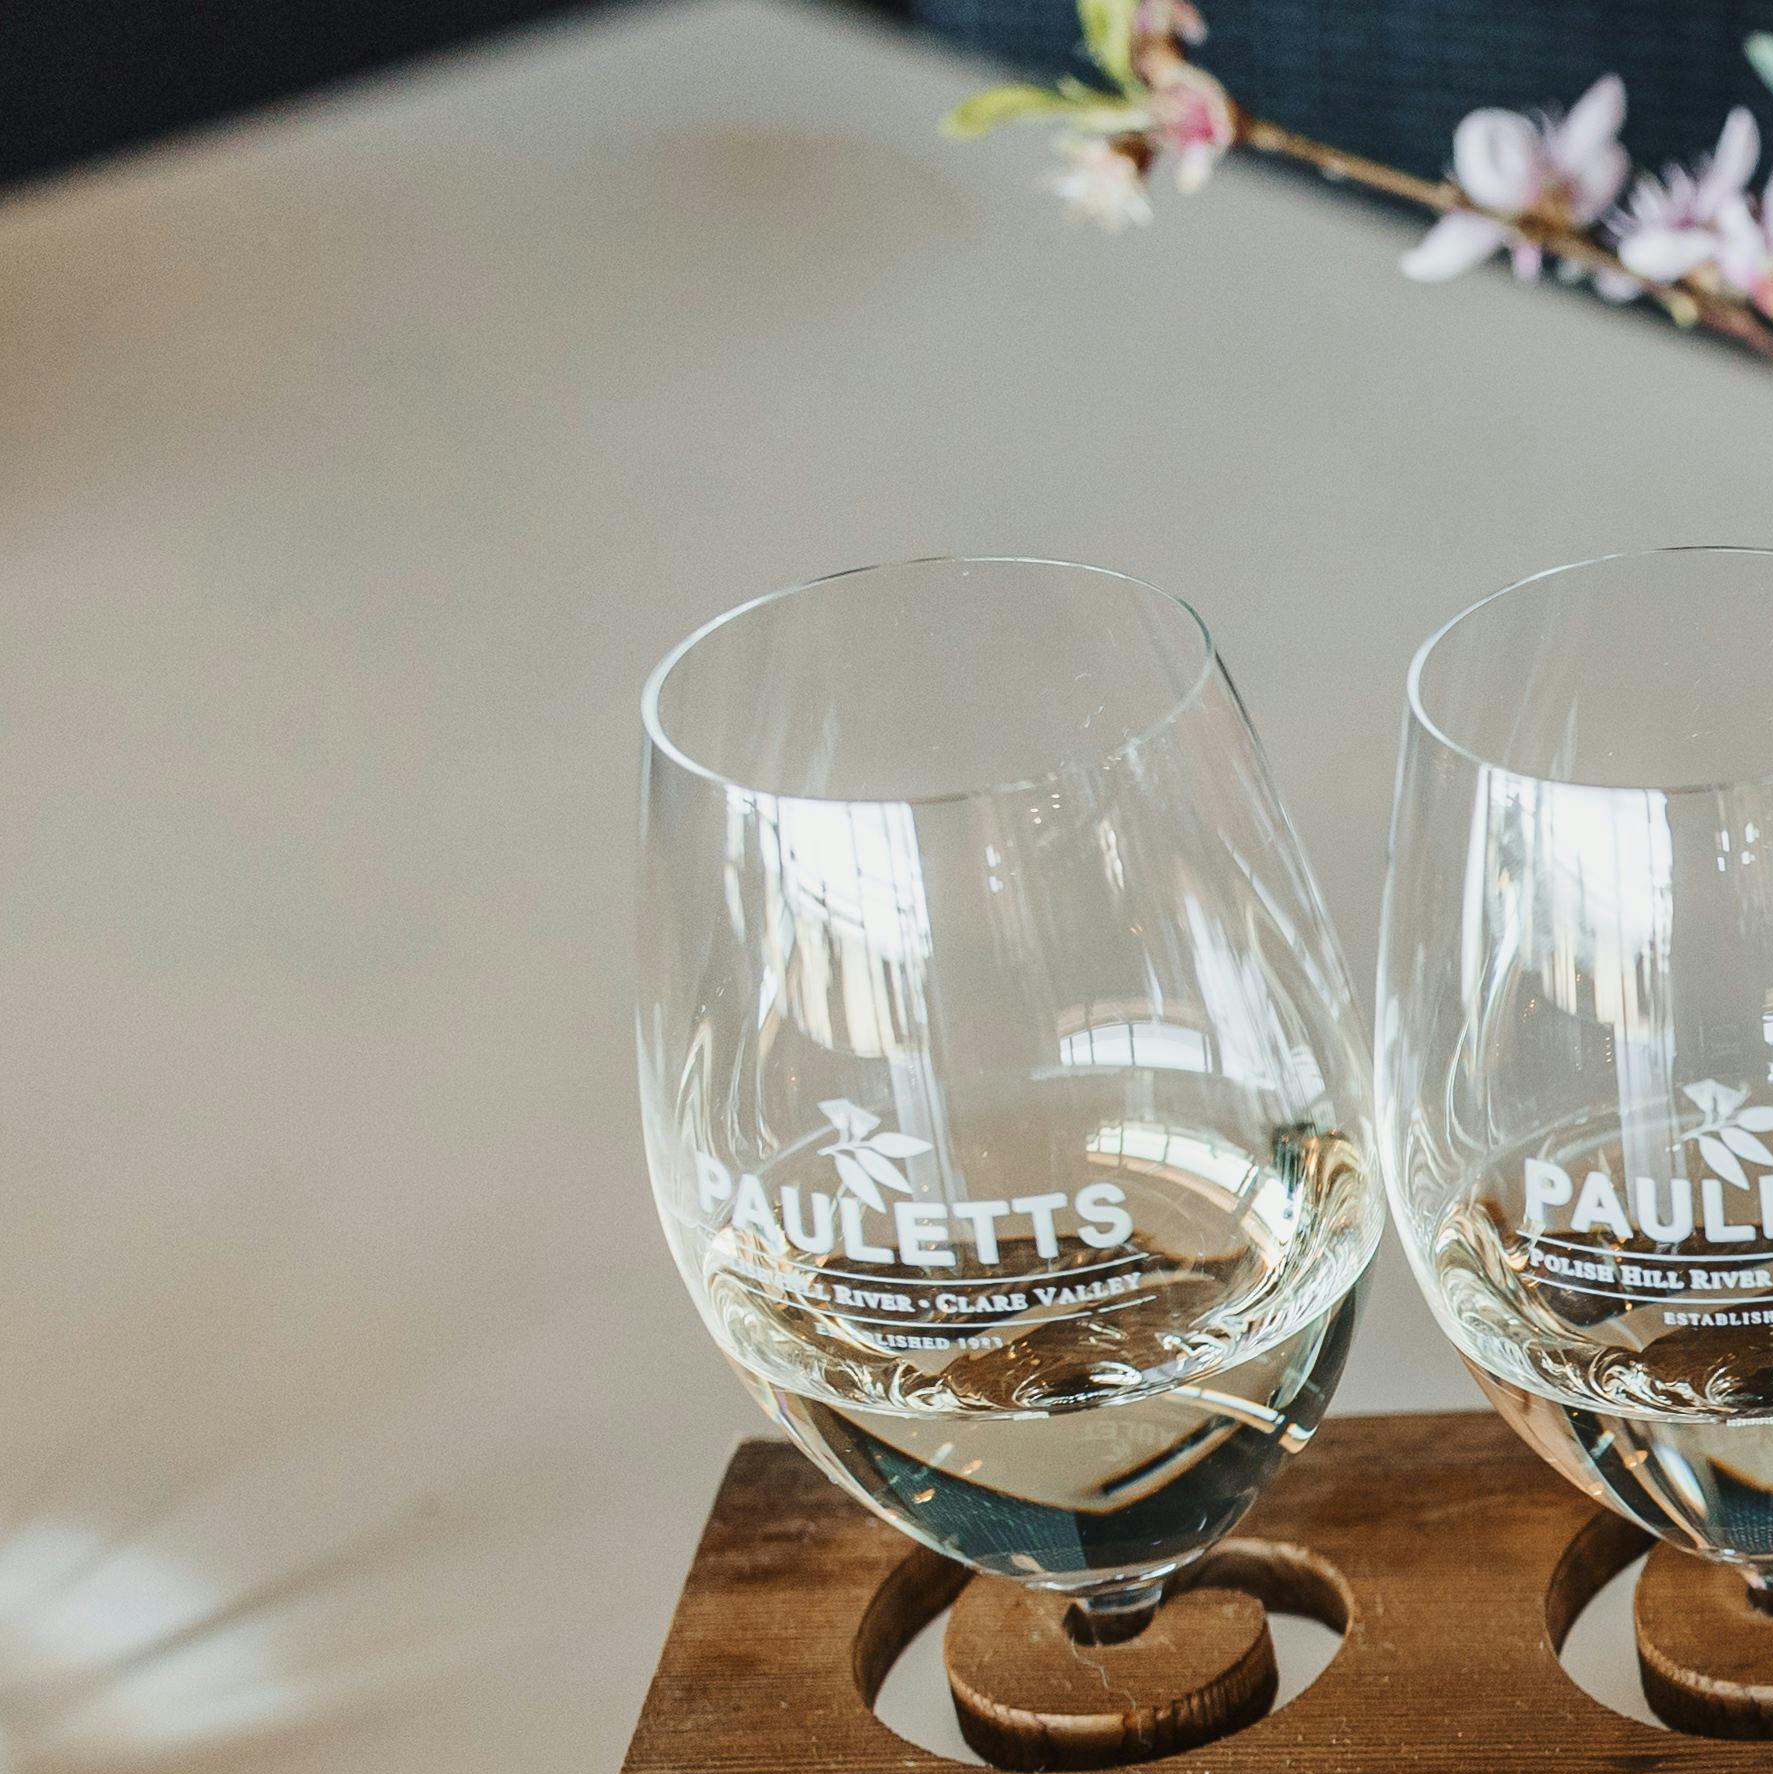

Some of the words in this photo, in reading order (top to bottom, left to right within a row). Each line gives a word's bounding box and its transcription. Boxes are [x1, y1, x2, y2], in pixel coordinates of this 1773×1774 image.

[696, 1151, 1133, 1267] PAULETTS
[1529, 1248, 1615, 1283] POLISH
[1620, 1265, 1684, 1289] HILL
[1689, 1269, 1773, 1290] RIVER
[833, 1284, 915, 1312] RIVER
[936, 1293, 1028, 1314] CLARE
[1033, 1272, 1141, 1306] VALLEY
